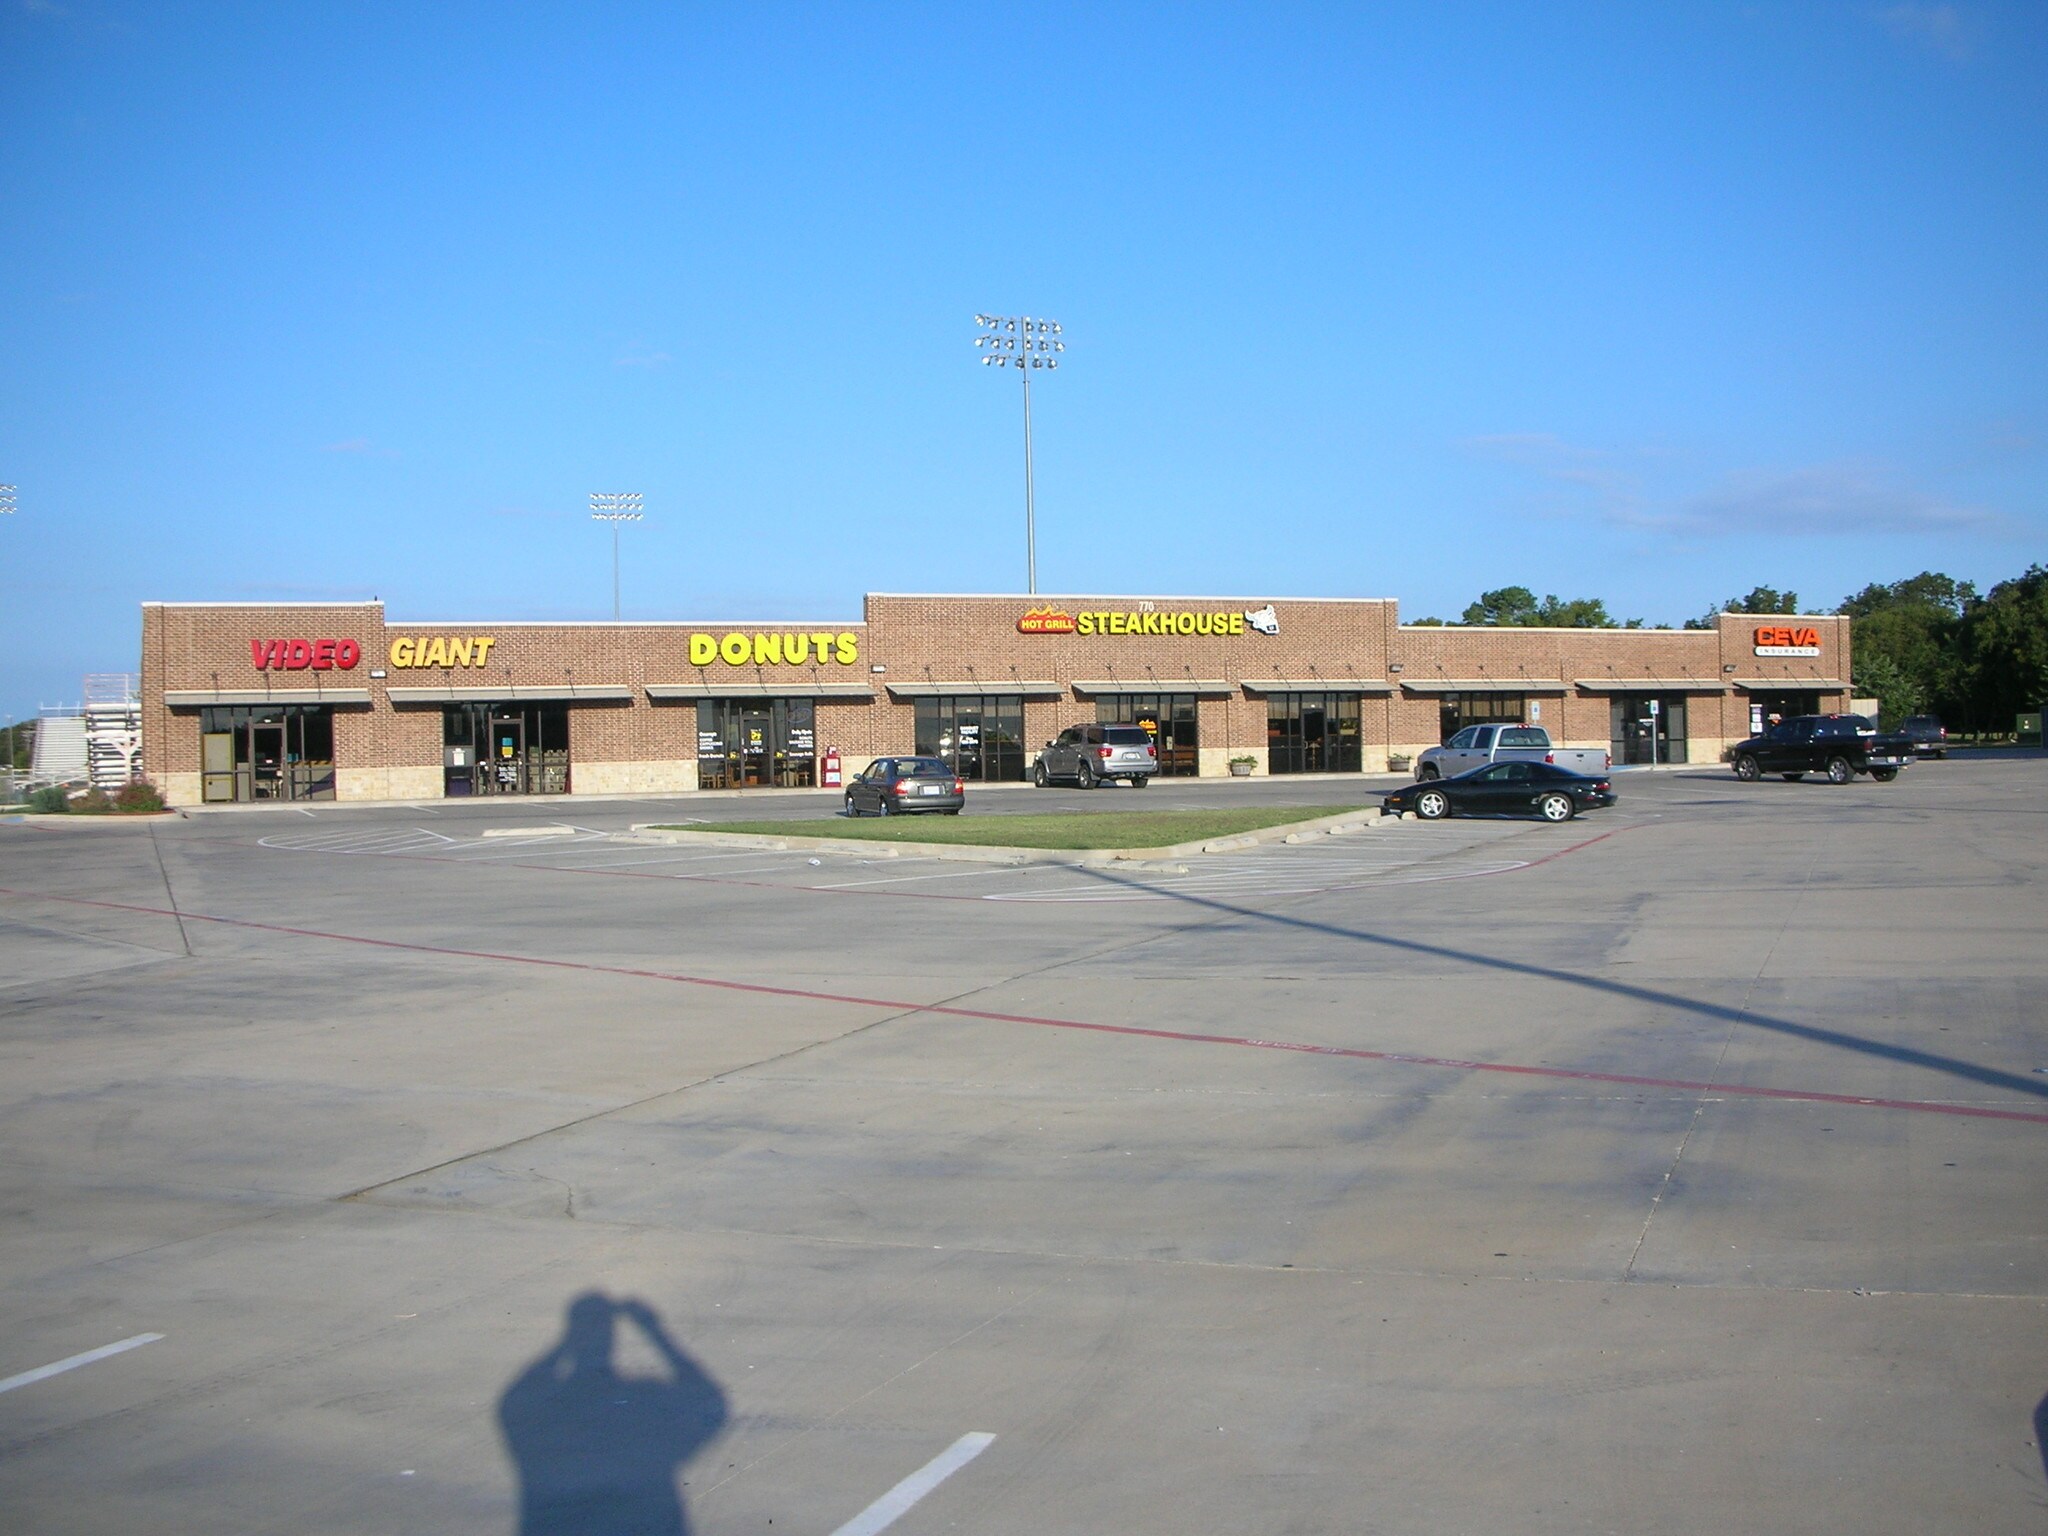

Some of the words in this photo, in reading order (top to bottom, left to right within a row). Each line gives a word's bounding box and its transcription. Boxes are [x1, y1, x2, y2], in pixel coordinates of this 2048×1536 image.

[1139, 601, 1155, 612] 770
[1021, 620, 1043, 630] HOT
[1045, 620, 1075, 630] GRILL
[1077, 611, 1245, 635] STEAKHOUSE
[1756, 626, 1822, 646] CEVA
[250, 638, 361, 669] VIDEO
[390, 637, 496, 669] GIANT
[689, 632, 858, 666] DONUTS
